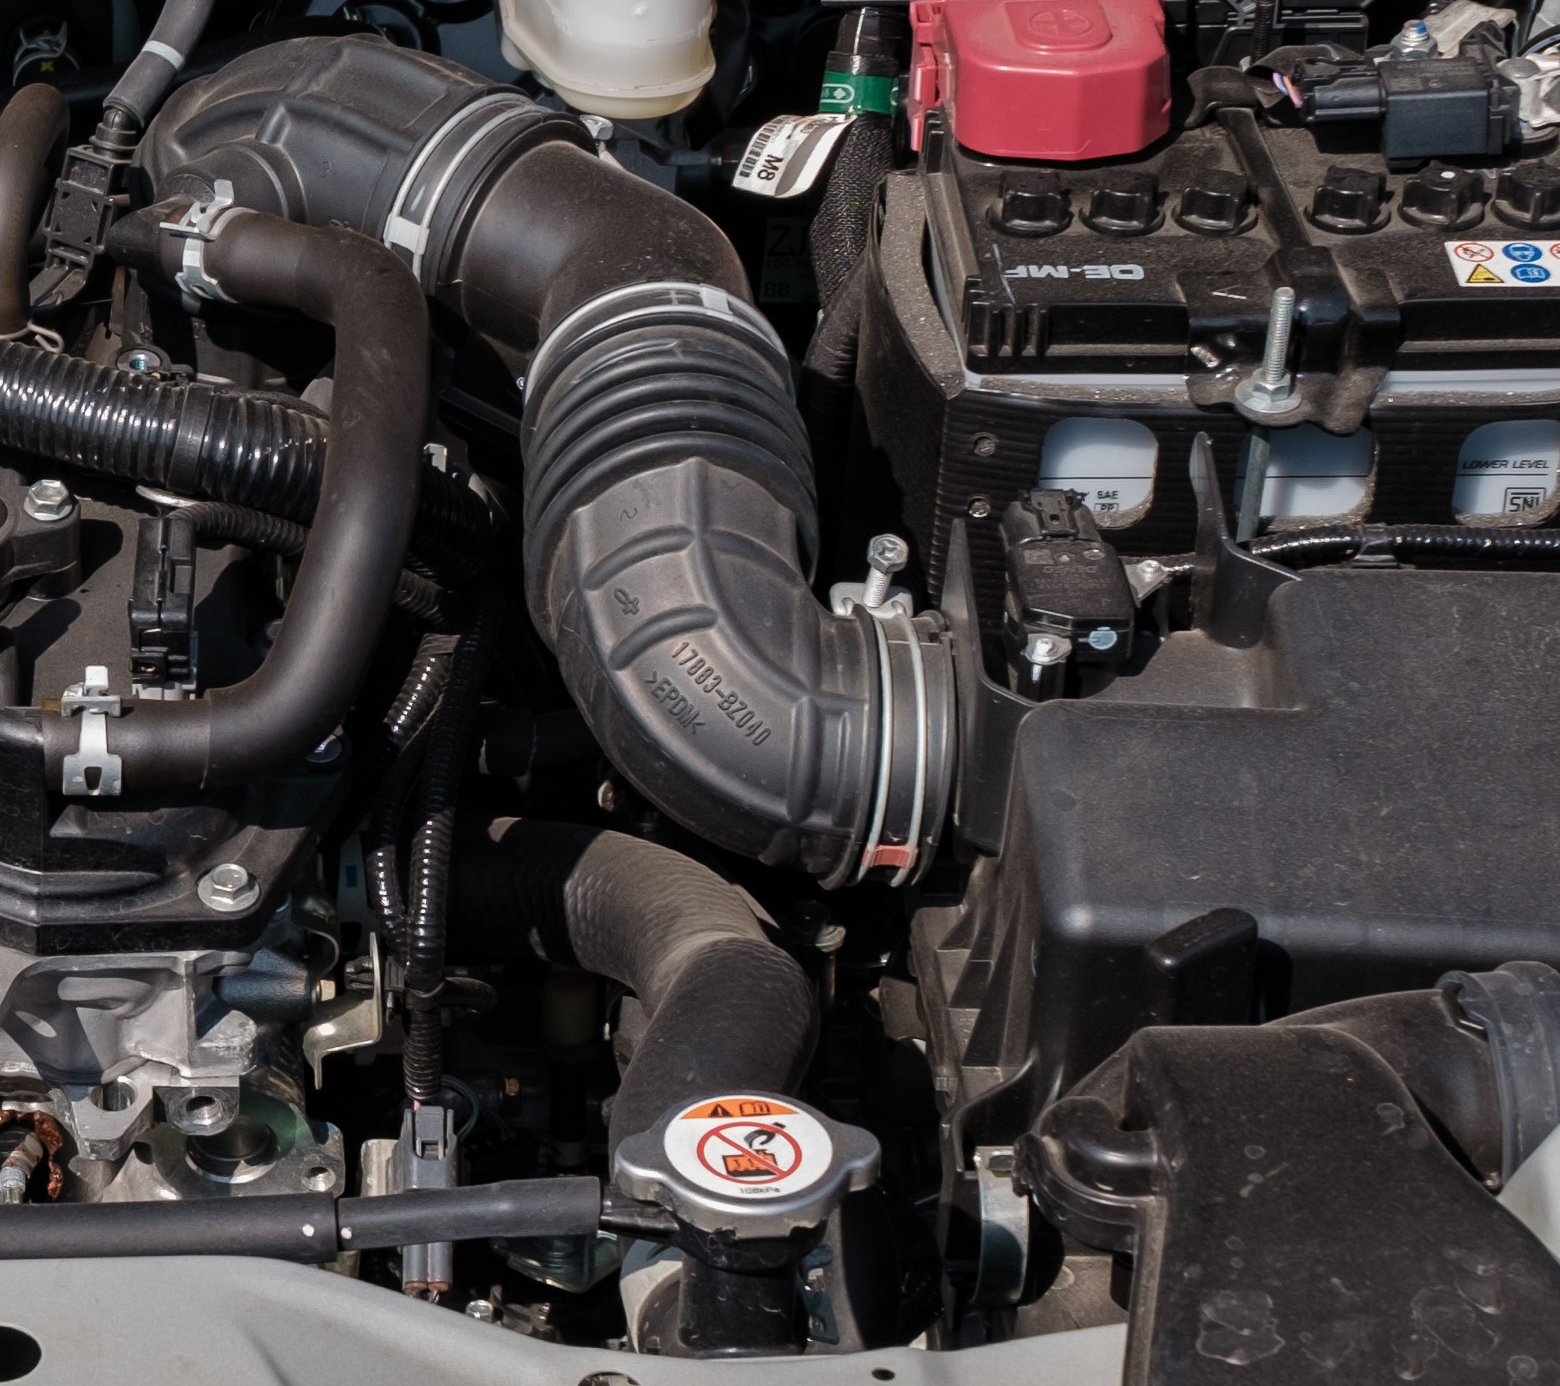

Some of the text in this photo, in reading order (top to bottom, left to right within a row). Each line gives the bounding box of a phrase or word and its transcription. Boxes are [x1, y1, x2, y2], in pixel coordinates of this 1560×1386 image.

[757, 154, 785, 182] M8
[1462, 459, 1551, 470] LOWER LEVEL
